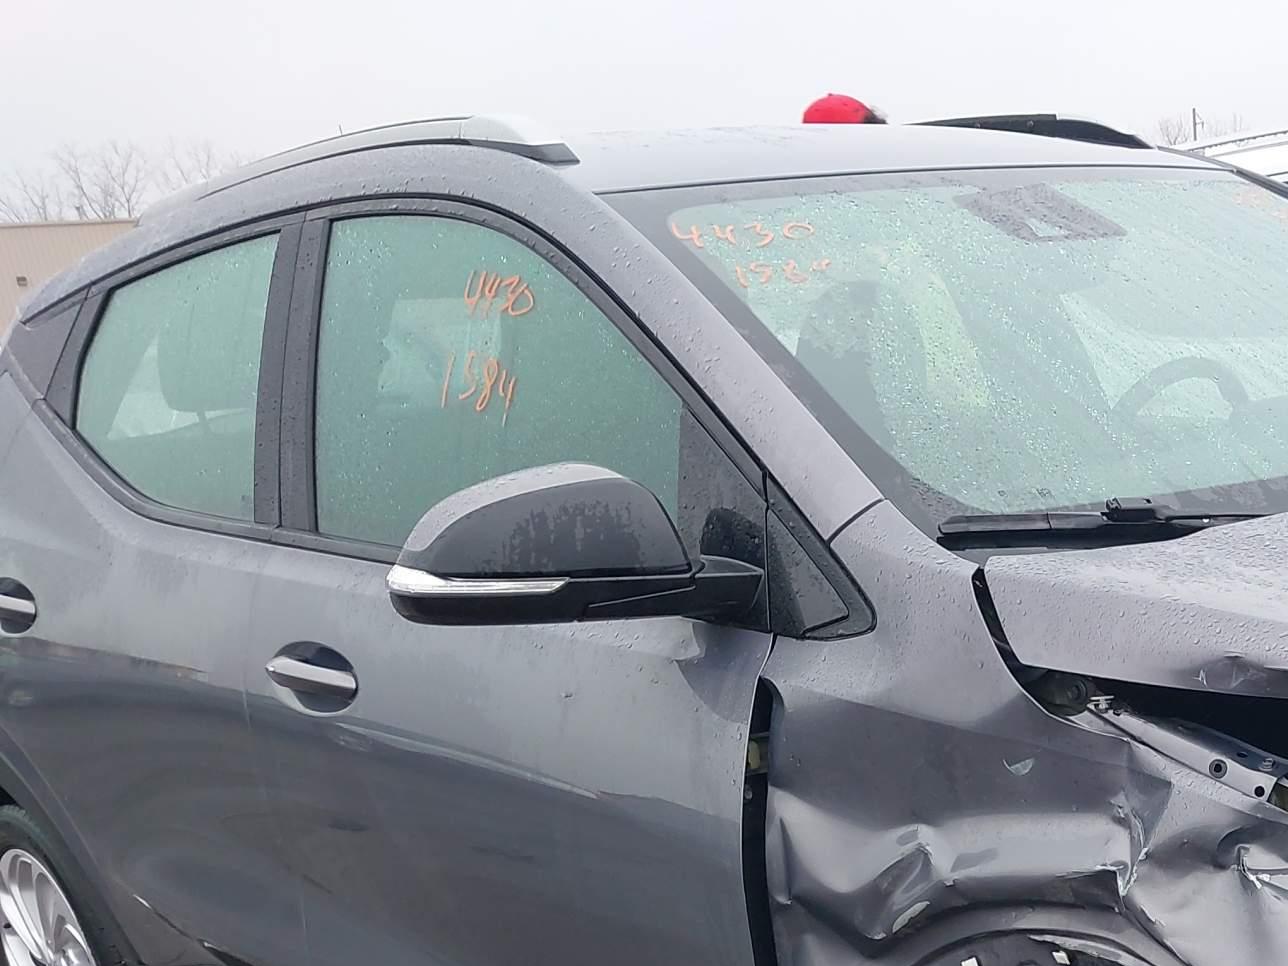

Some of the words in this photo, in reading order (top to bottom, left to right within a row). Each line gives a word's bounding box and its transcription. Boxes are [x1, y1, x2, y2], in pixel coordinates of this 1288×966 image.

[671, 221, 816, 249] 4430
[463, 269, 535, 320] 4430
[440, 350, 517, 428] 1584
